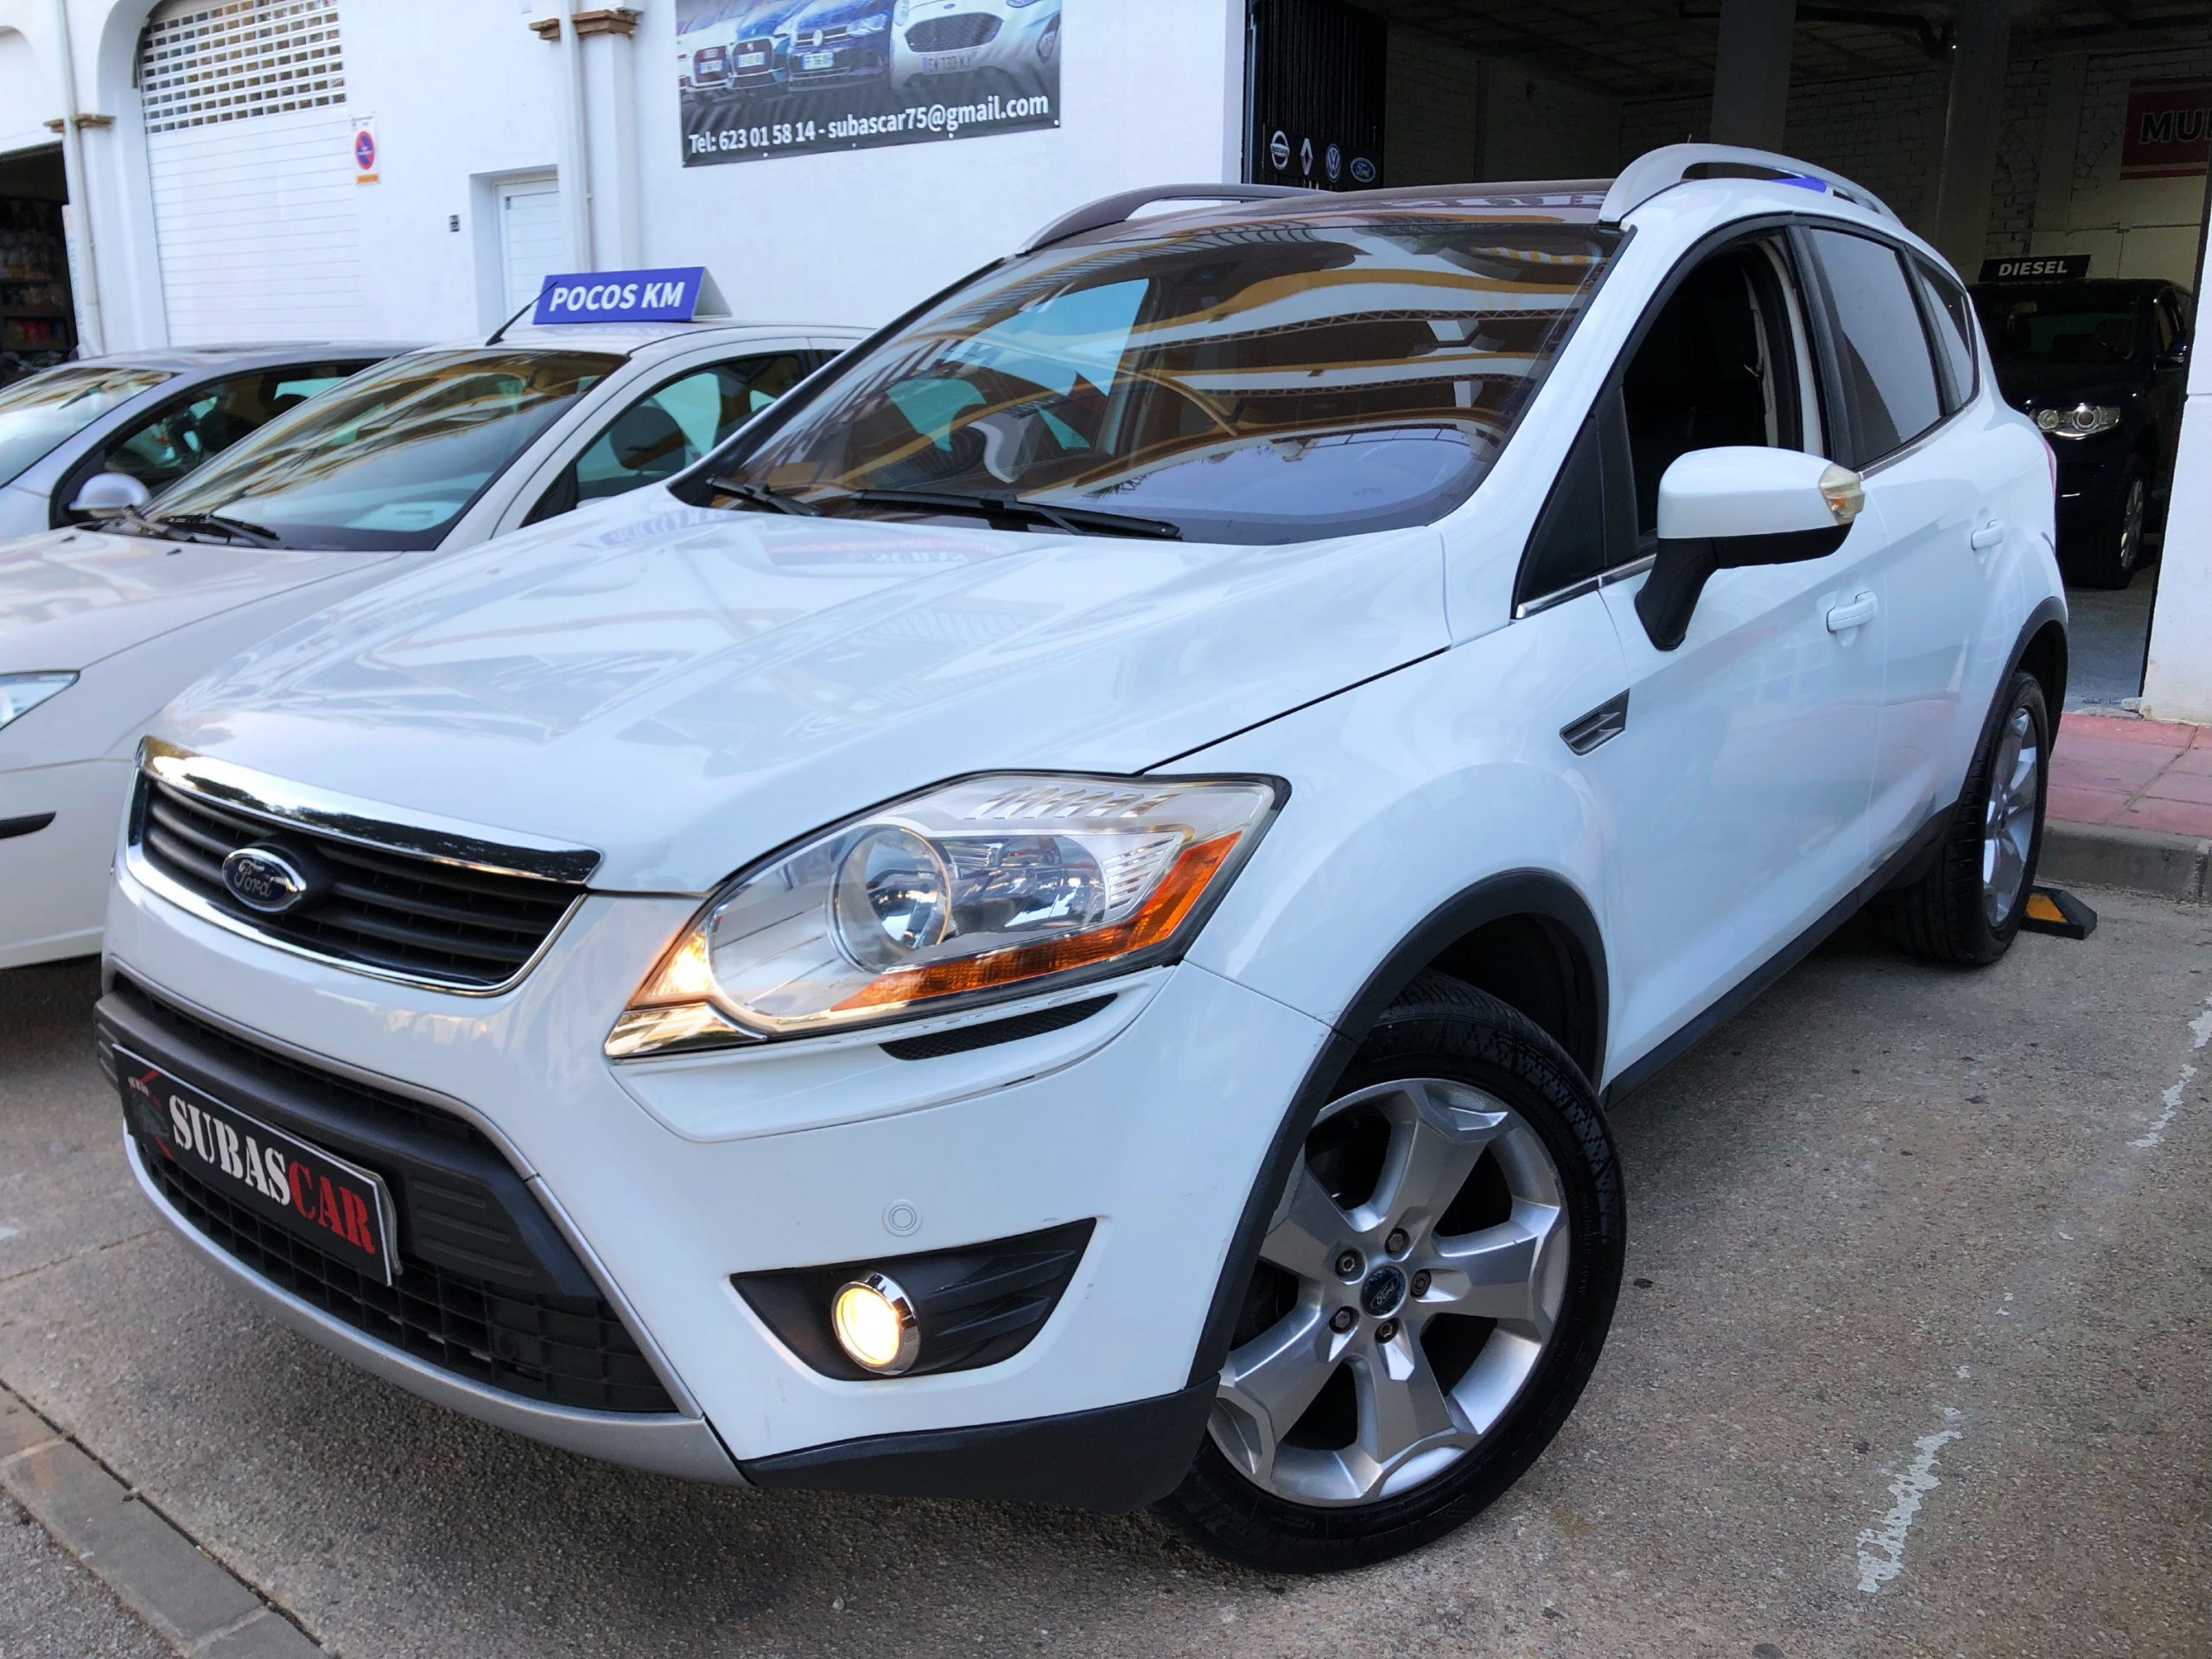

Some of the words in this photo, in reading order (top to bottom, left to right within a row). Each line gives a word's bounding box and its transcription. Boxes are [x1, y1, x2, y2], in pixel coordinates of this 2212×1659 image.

[688, 131, 717, 154] Tel:
[719, 128, 748, 151] 623
[749, 125, 770, 148] 01
[772, 123, 792, 145] 58
[795, 120, 816, 142] 14
[827, 95, 1049, 139] subascar75@gmail.com
[2139, 108, 2212, 145] MU
[1998, 260, 2069, 276] DIESEL
[549, 283, 639, 313] POCOS
[640, 281, 685, 309] KM
[168, 1094, 376, 1254] SUBASCAR
